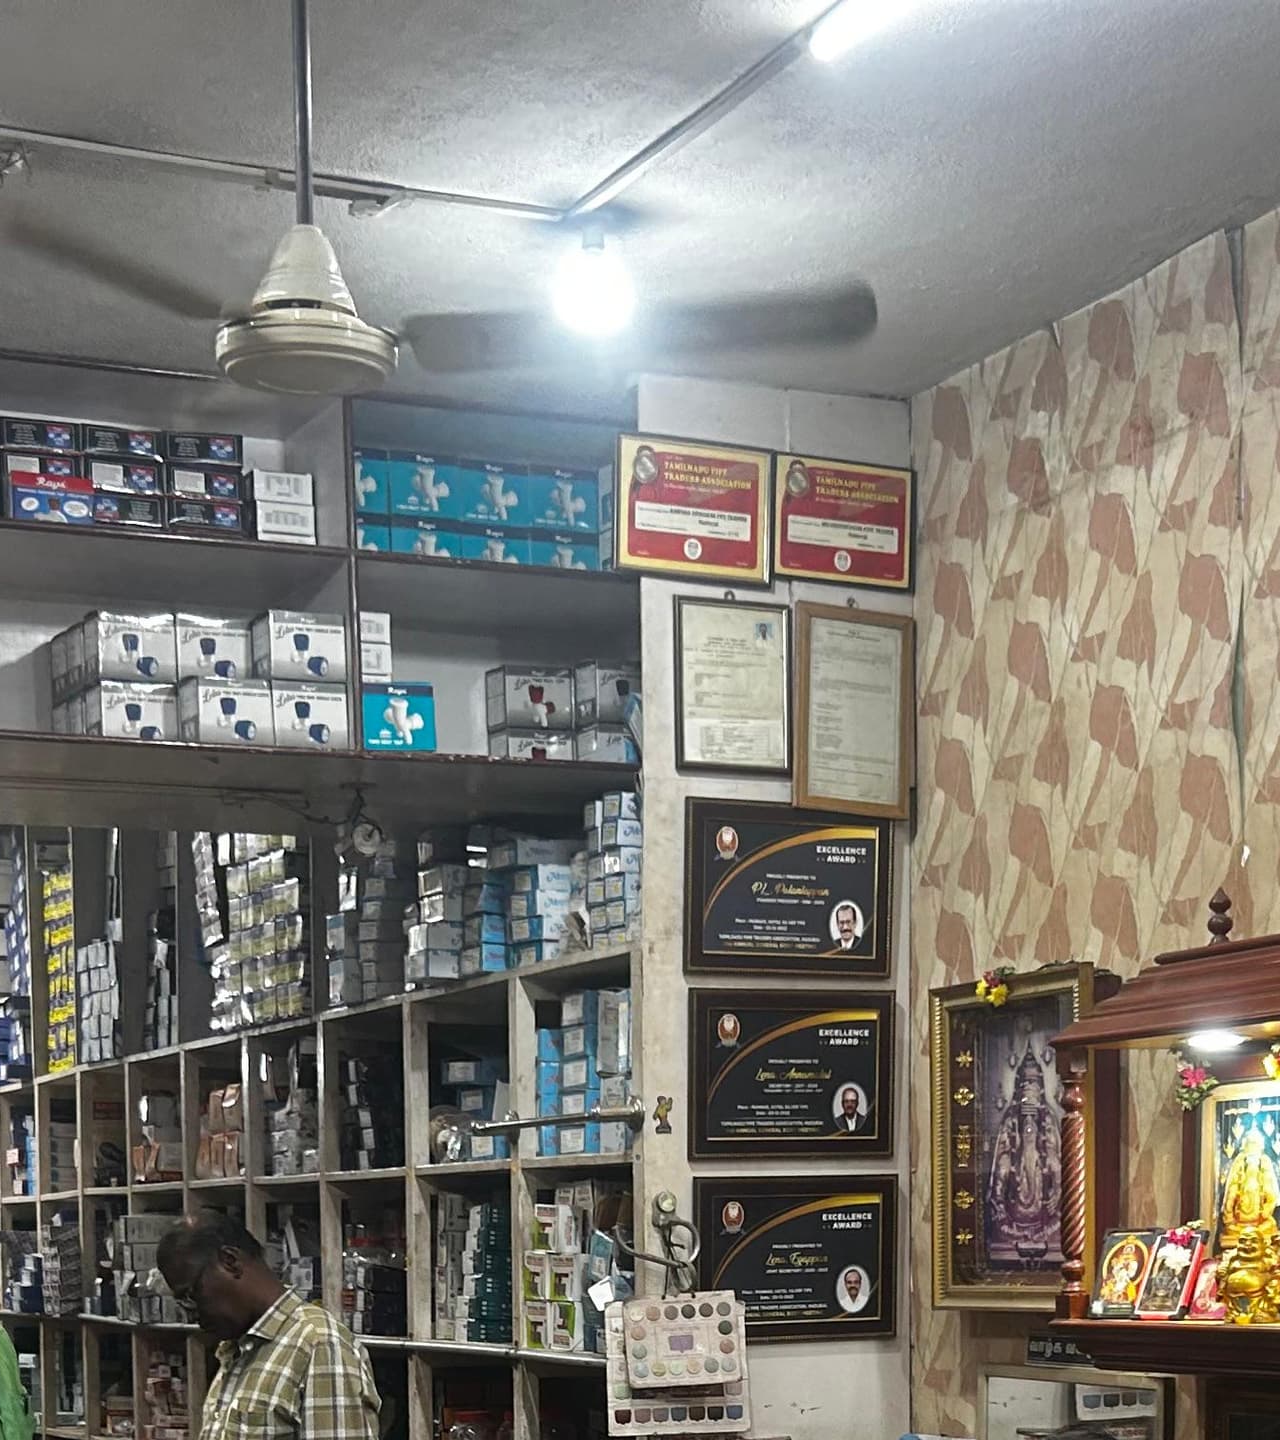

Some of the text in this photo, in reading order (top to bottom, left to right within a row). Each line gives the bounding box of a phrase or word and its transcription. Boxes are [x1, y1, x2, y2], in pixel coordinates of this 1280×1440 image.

[816, 845, 867, 856] EXCELLENCE
[826, 855, 856, 864] AWARD
[819, 1029, 869, 1037] EXCELLENCE
[829, 1038, 859, 1046] AWARD
[822, 1213, 872, 1221] EXCELLENCE
